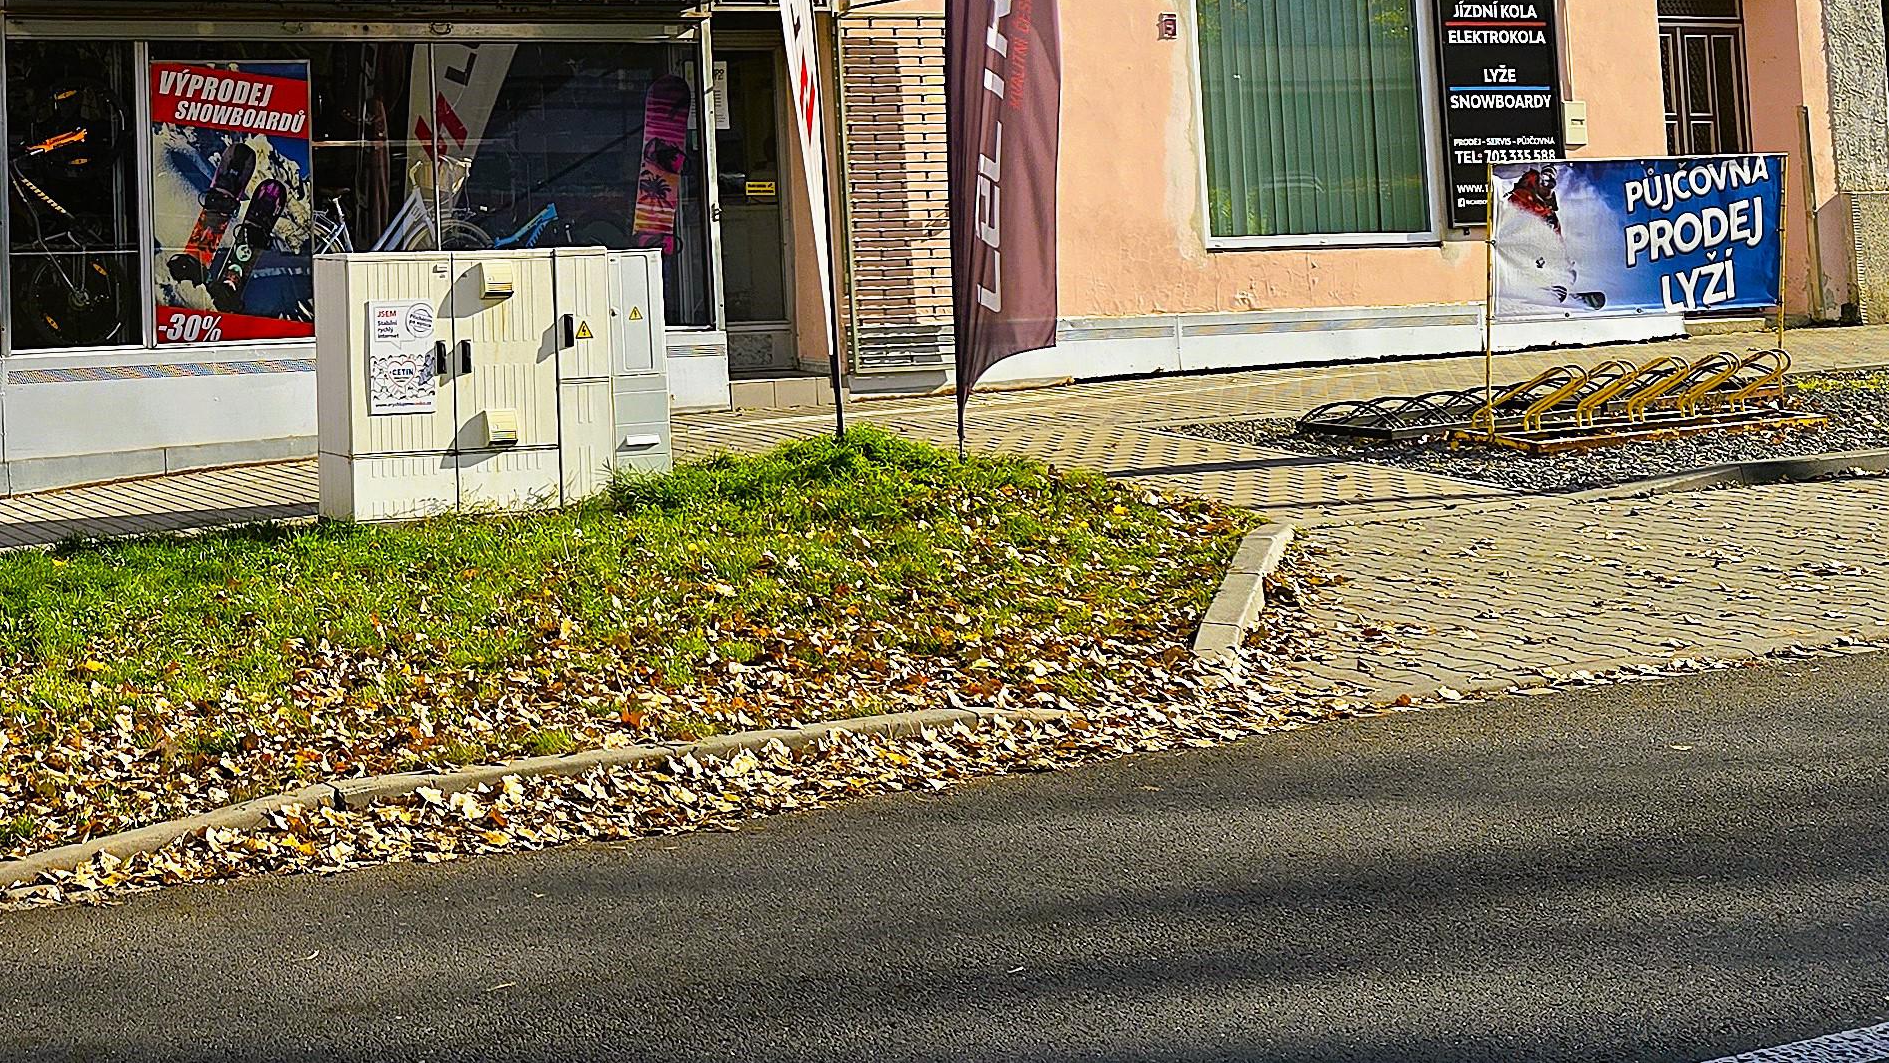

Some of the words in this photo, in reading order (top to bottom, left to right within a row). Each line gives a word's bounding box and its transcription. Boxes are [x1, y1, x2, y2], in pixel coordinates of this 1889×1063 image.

[1453, 0, 1499, 18] JÍZDNÍ
[1501, 4, 1538, 19] KOLA
[1448, 29, 1546, 45] ELEKTROKOLA
[1483, 64, 1517, 84] LYŽE
[158, 69, 274, 108] VÝPRODEJ
[1450, 94, 1551, 110] SNOWBOARDY
[174, 100, 306, 134] SNOWBOARDŮ
[1454, 150, 1483, 164] TEL:
[1625, 156, 1769, 213] PŮJČOVNA
[1625, 196, 1763, 268] PRODEJ
[1661, 247, 1736, 314] LYŽÍ
[377, 310, 397, 318] JSEM
[158, 313, 223, 343] -30%
